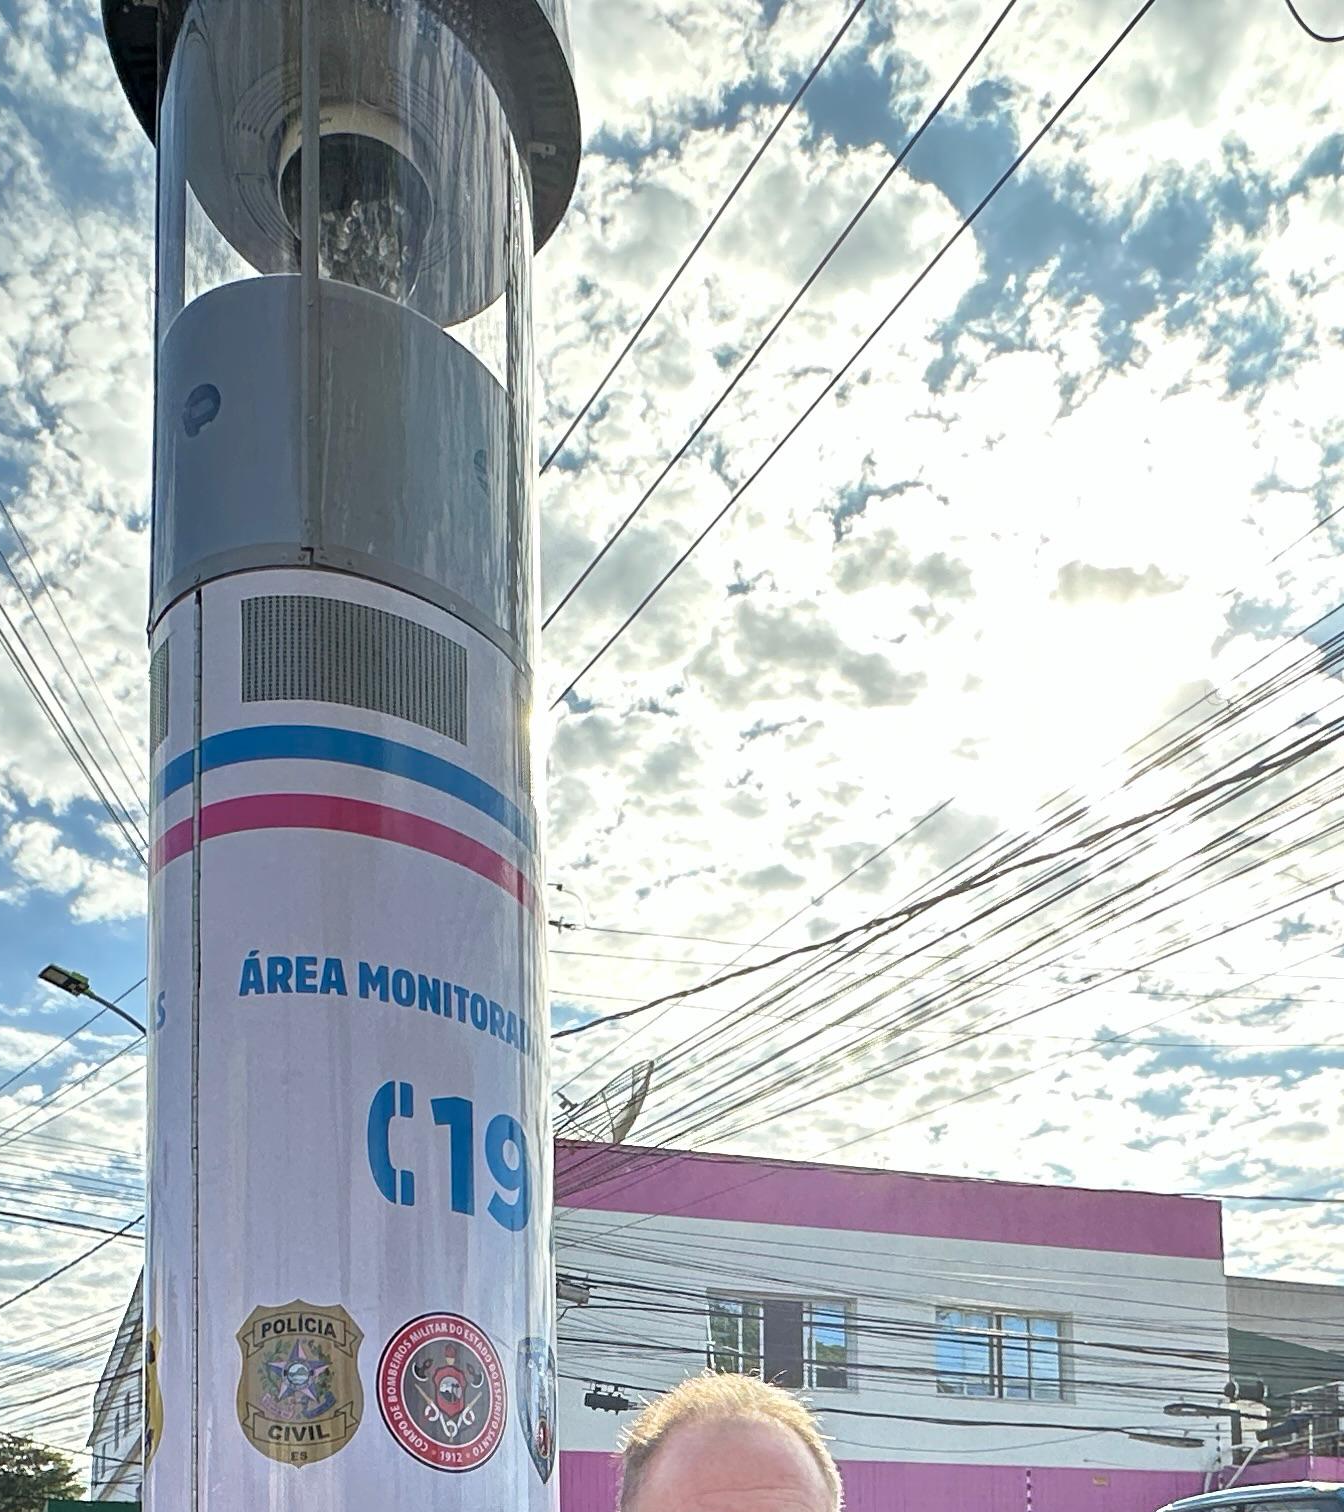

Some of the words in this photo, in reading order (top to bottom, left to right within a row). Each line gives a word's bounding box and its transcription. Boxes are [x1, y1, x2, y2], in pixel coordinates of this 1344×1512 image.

[238, 949, 348, 997] ÁREA
[261, 1314, 337, 1339] POLÍCIA
[409, 1322, 449, 1342] MILITAR
[449, 1325, 463, 1335] DO
[463, 1329, 492, 1362] ESTADO
[386, 1342, 412, 1403] BOMBEIROS
[390, 1405, 403, 1420] DE
[267, 1424, 330, 1442] CIVIL
[399, 1420, 428, 1453] CORPO
[439, 1451, 463, 1463] 1912
